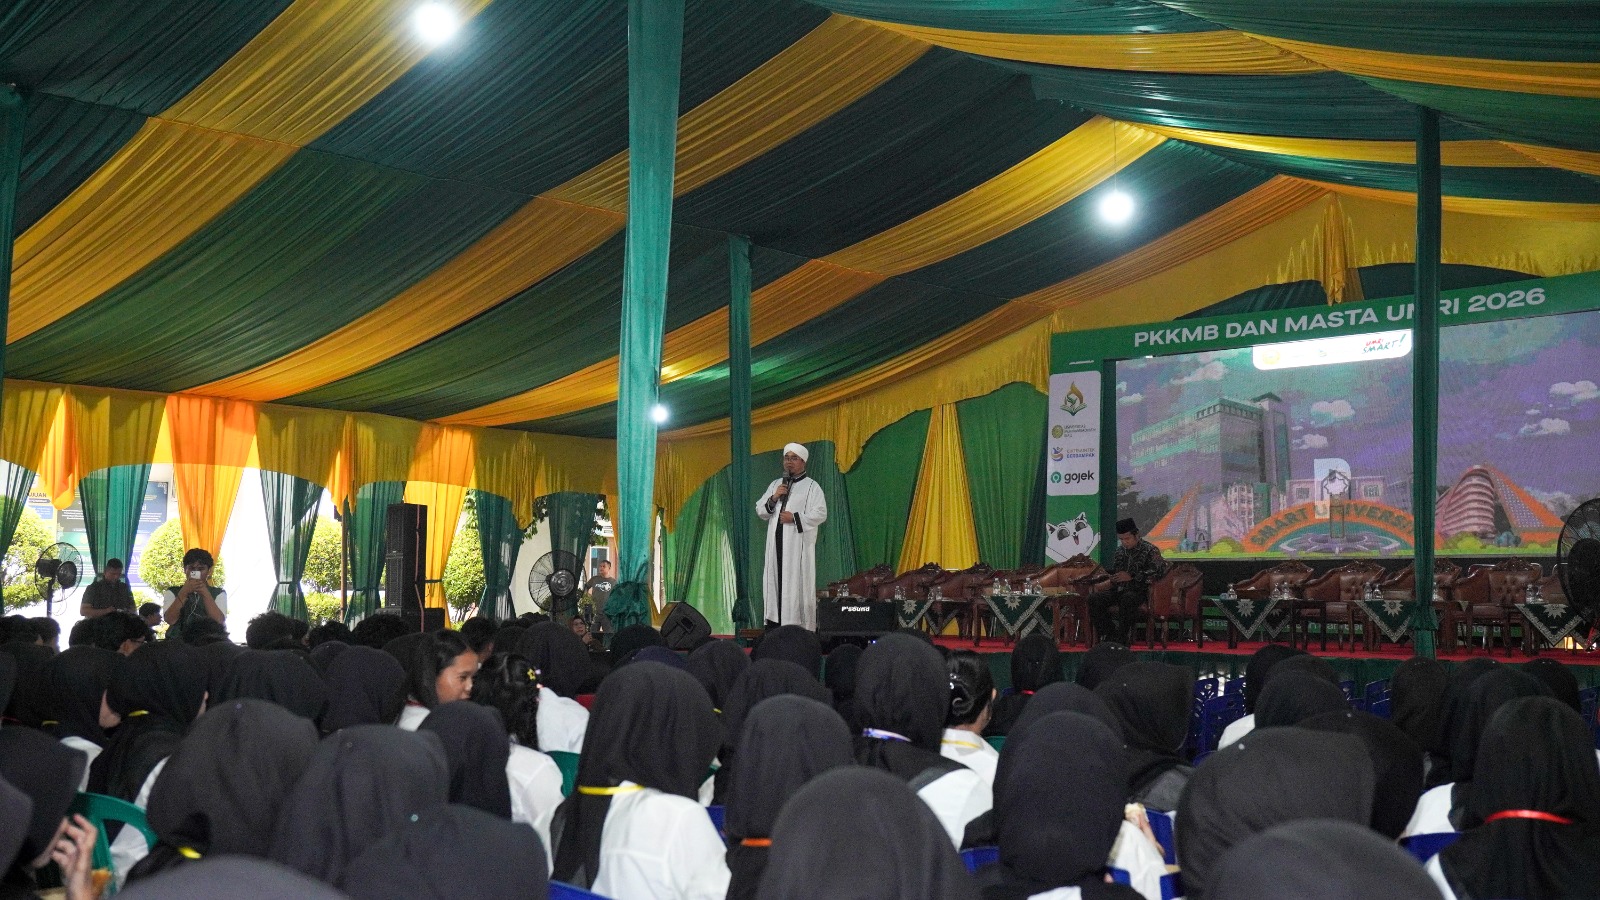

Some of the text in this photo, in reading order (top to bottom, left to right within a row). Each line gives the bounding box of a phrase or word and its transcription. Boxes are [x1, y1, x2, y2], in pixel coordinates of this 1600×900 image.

[1134, 324, 1219, 347] PKKMB
[1225, 318, 1278, 339] DAN
[1284, 307, 1379, 333] MASTA
[1467, 287, 1546, 313] 2026
[1064, 470, 1095, 484] gojek
